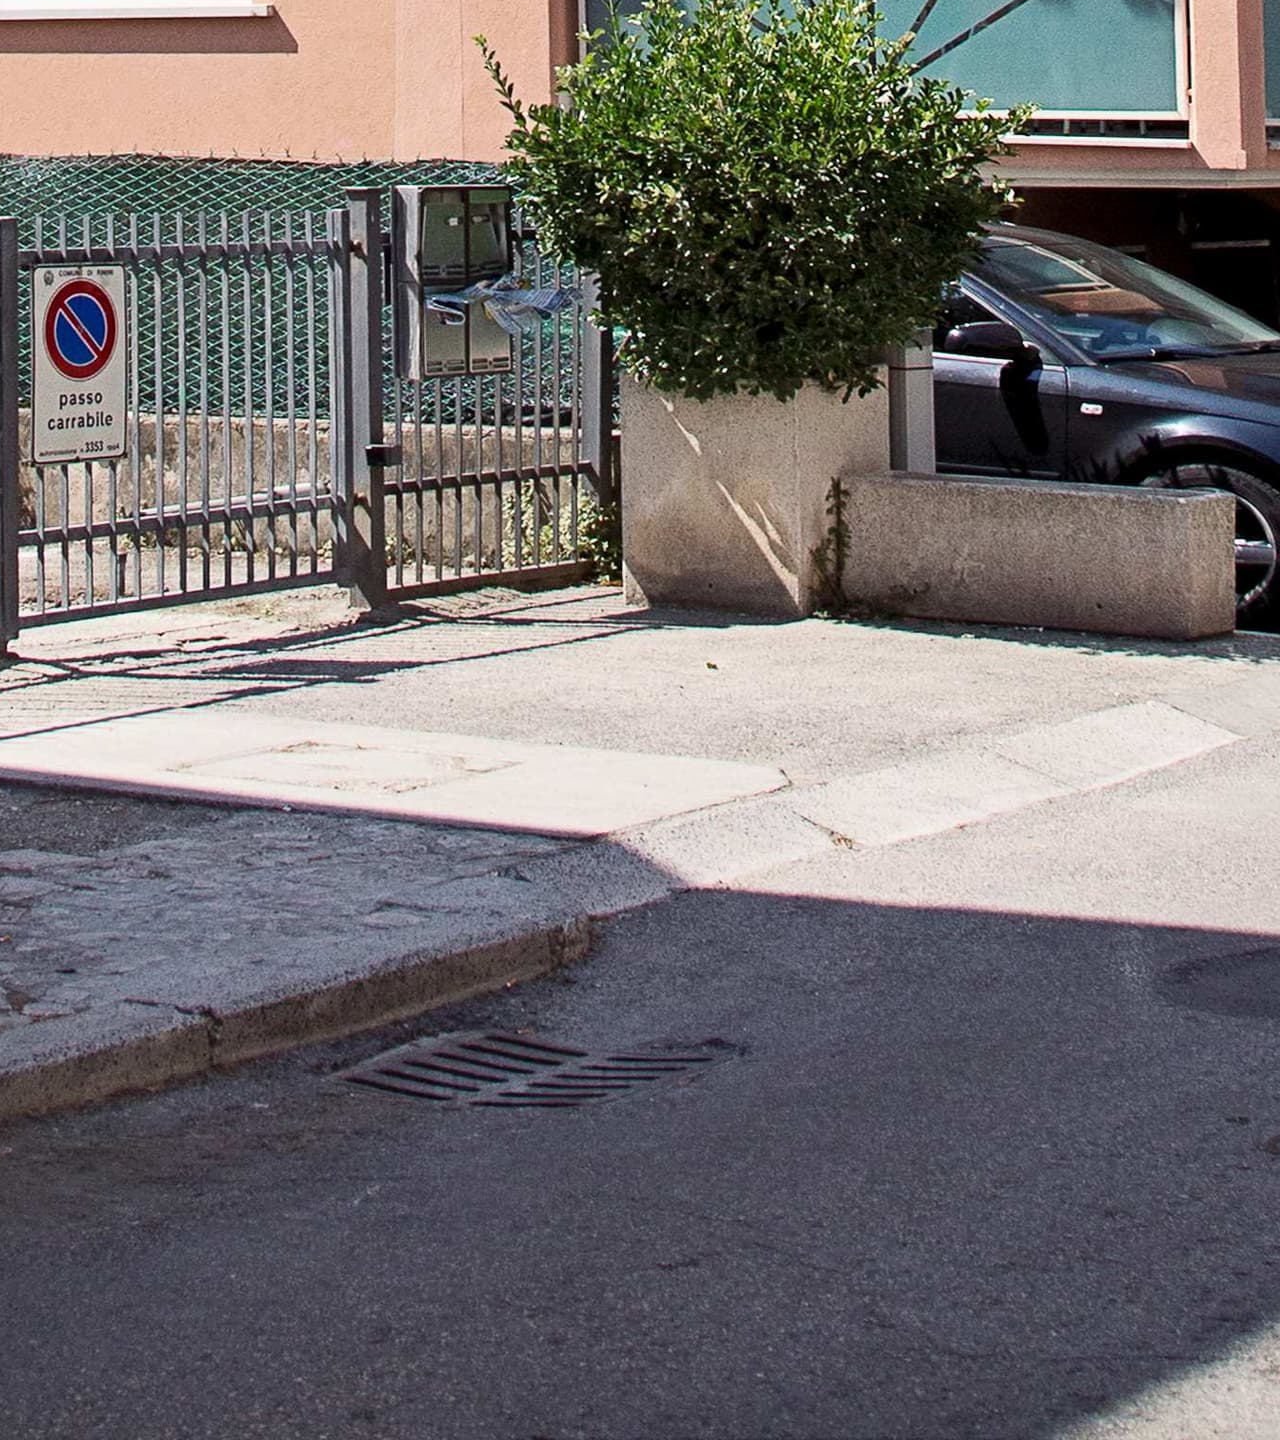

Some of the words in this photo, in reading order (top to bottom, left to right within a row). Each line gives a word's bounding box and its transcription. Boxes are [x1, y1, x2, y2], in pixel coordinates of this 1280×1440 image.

[59, 391, 103, 410] passo
[47, 411, 114, 431] carrabile
[84, 440, 104, 453] 3353
